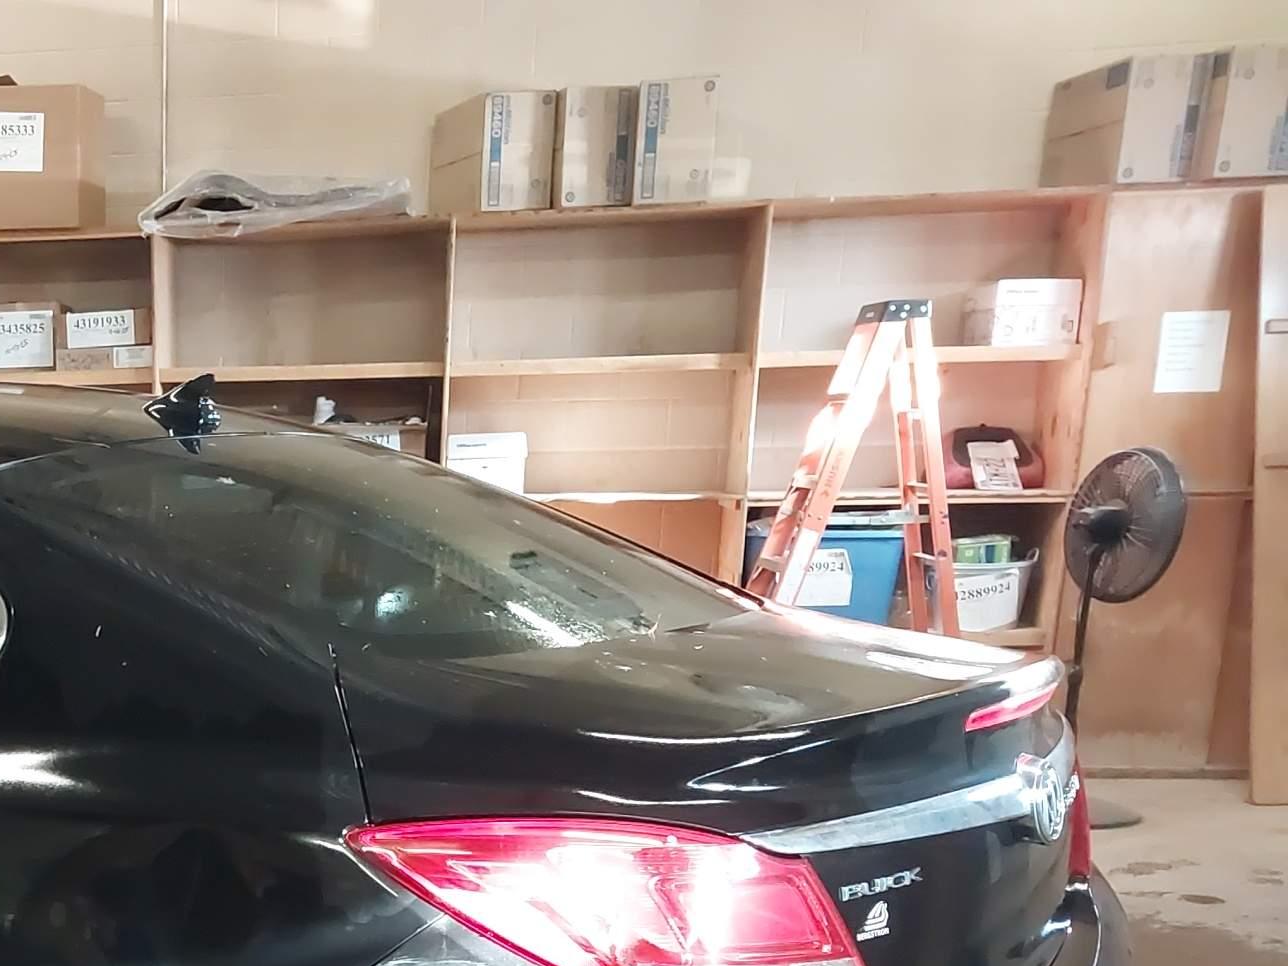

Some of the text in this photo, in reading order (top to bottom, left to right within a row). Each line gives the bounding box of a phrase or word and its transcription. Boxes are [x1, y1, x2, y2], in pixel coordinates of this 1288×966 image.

[73, 315, 126, 329] 43191933
[955, 582, 1011, 601] 2889924
[839, 867, 923, 902] BUICK
